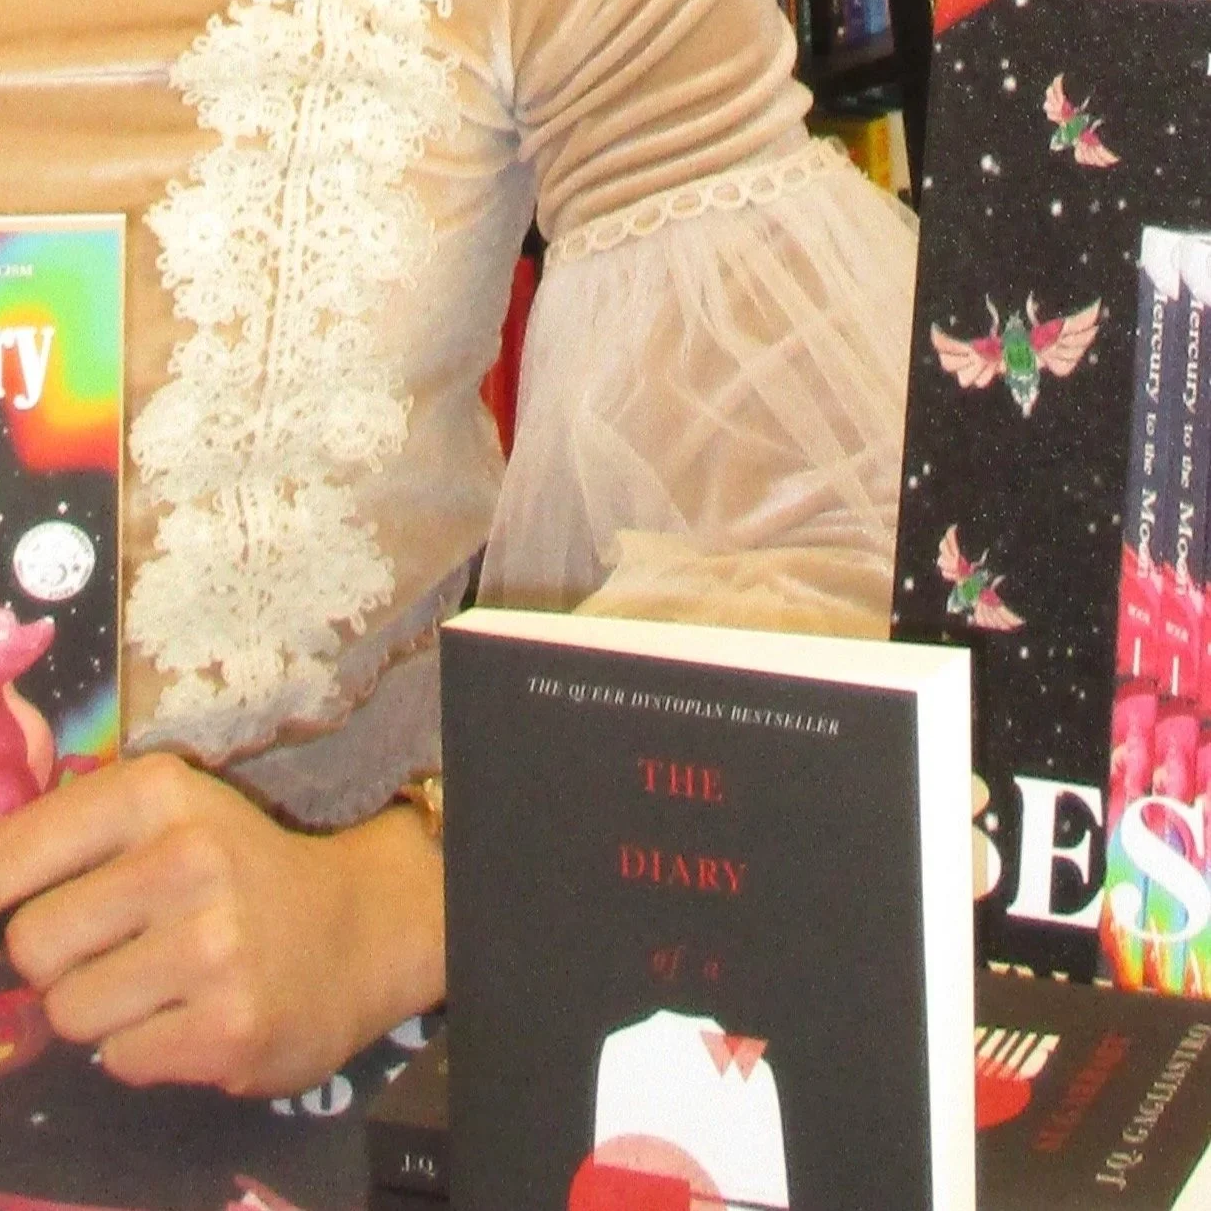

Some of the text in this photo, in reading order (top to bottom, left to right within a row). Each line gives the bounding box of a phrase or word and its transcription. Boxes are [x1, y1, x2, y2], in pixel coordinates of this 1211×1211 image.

[1144, 411, 1158, 438] to
[1182, 424, 1194, 449] to
[1142, 442, 1156, 477] the
[1180, 454, 1193, 489] the
[1137, 488, 1158, 580] Moon
[527, 676, 841, 736] THE QUEER DYSTOPIAN BESTSELLER
[637, 756, 724, 804] THE
[620, 844, 747, 897] DIARY
[651, 944, 722, 982] of a
